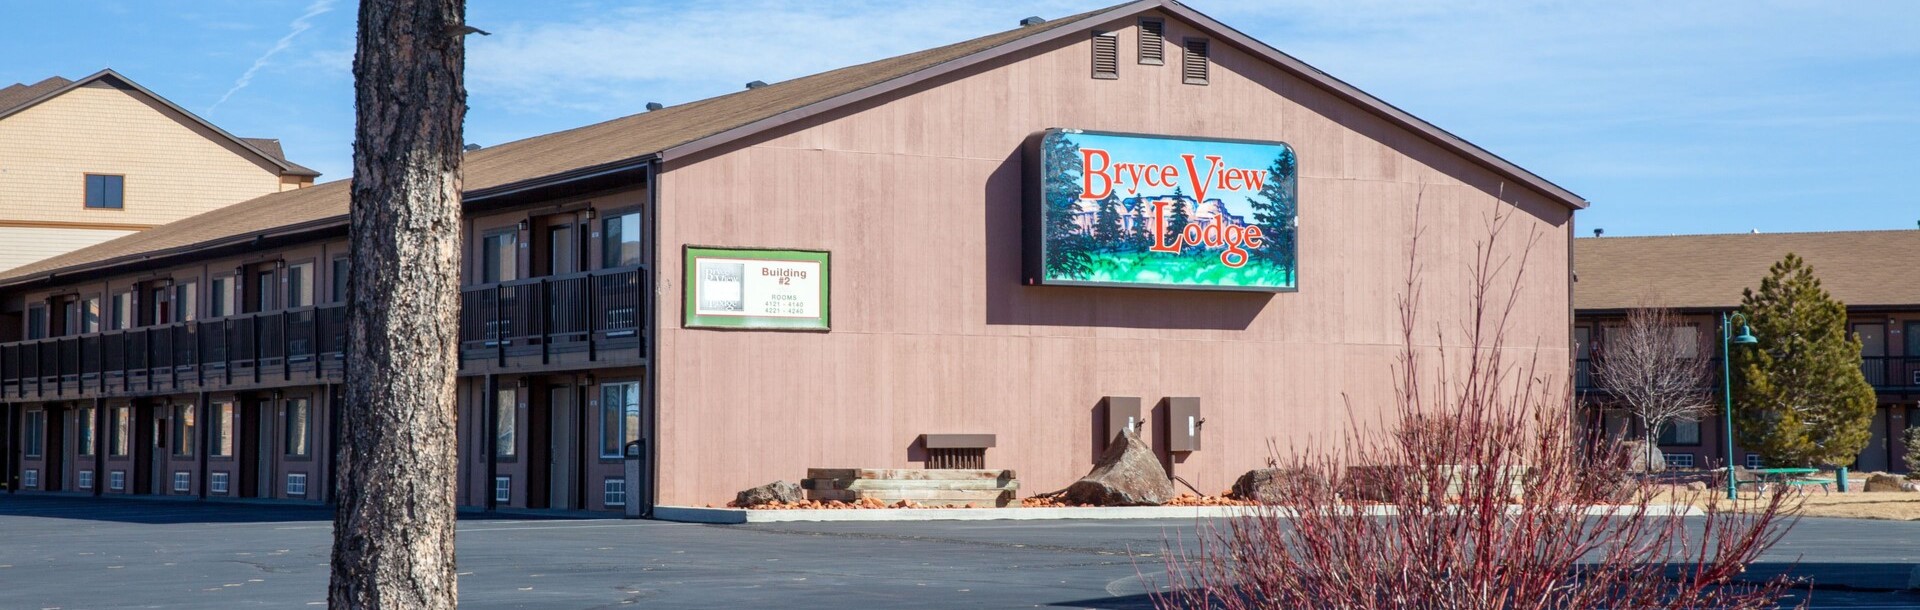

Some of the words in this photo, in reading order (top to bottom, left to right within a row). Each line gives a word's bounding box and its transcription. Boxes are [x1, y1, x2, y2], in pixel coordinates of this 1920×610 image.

[1079, 149, 1178, 199] Bryce
[1181, 154, 1267, 204] View
[1150, 201, 1263, 268] Lodge
[762, 267, 807, 279] Building
[778, 277, 791, 286] #2
